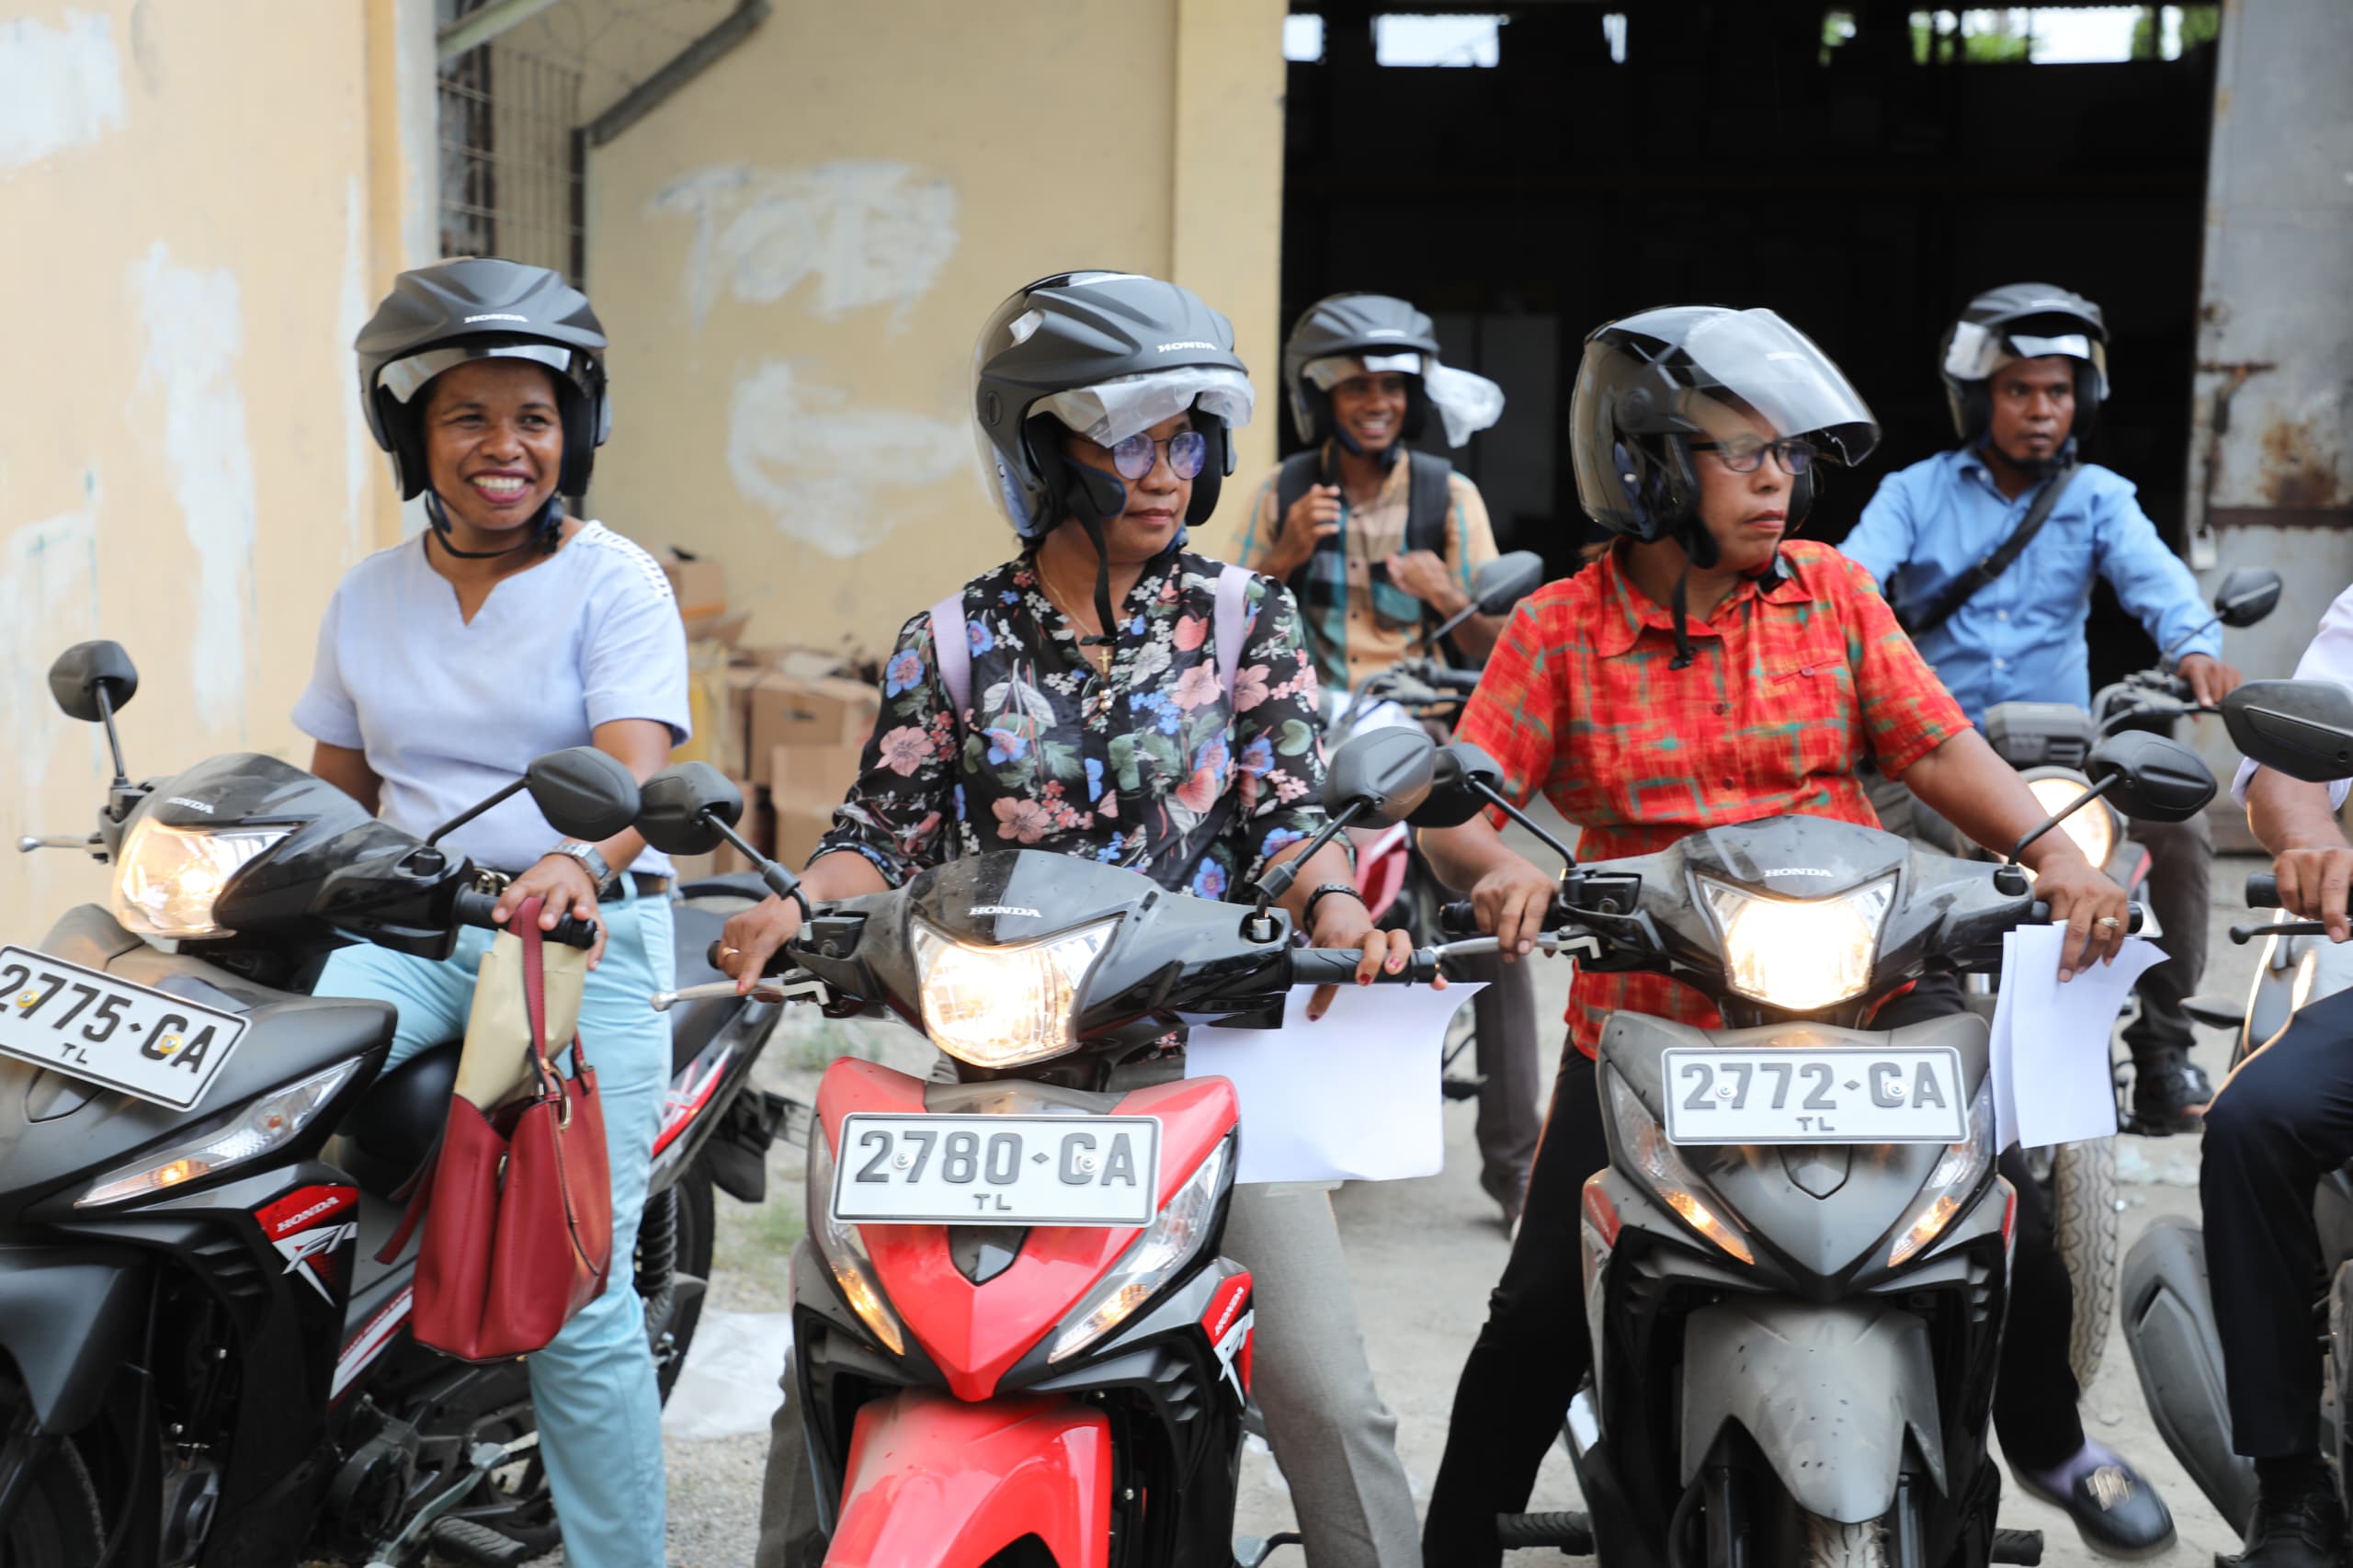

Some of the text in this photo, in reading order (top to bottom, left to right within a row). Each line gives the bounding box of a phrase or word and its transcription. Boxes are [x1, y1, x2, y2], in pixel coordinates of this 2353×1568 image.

[1157, 341, 1217, 353] HONDA
[1765, 868, 1835, 878] HONDA
[969, 905, 1043, 918] HONDA
[61, 1042, 88, 1064] TL
[1796, 1116, 1836, 1131] TL
[972, 1193, 1013, 1210] TL
[277, 1196, 340, 1233] HONDA
